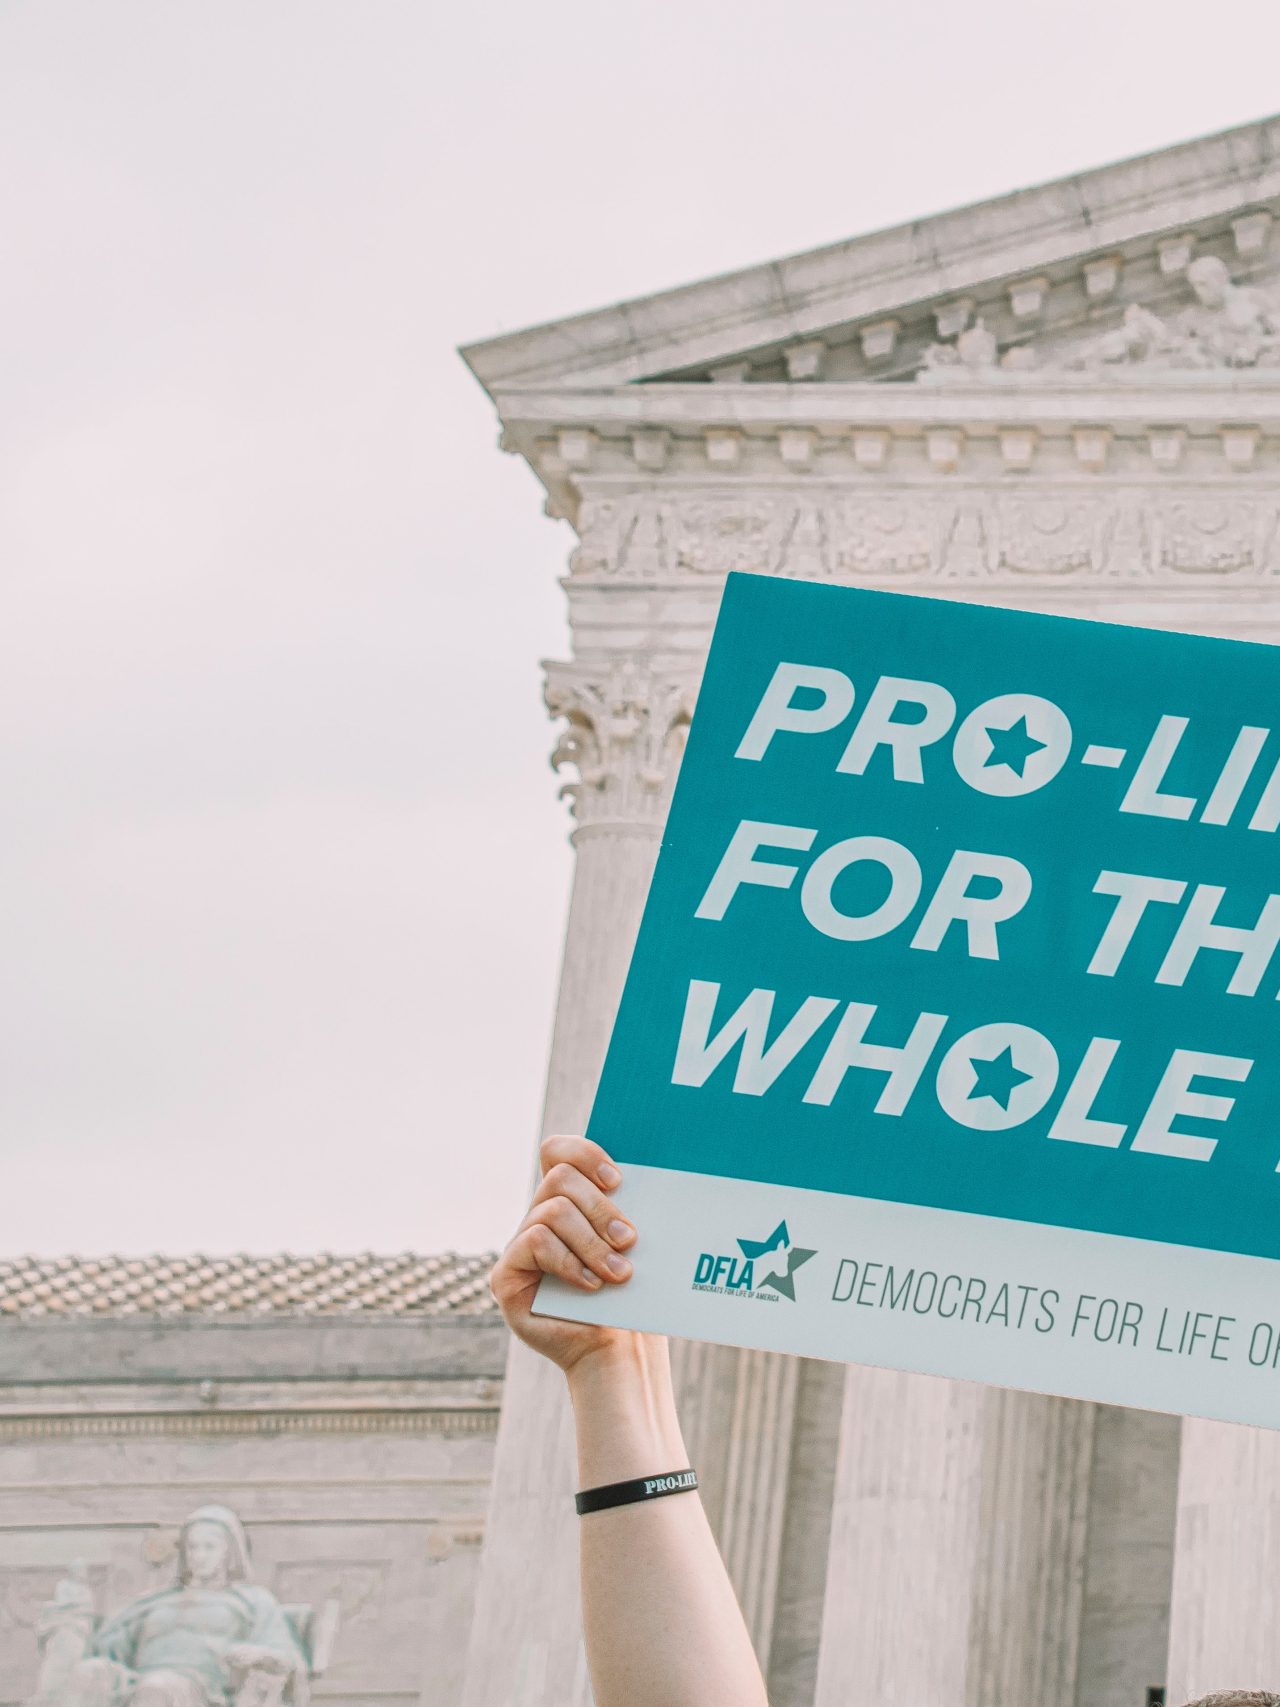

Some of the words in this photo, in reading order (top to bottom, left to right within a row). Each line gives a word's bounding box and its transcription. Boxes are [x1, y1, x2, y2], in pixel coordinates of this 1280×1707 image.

[694, 820, 1033, 961] FOR
[671, 979, 1254, 1162] WHOLE
[691, 1283, 723, 1294] DEMOCRATS
[724, 1287, 735, 1296] FOR
[735, 1289, 747, 1298] LIFE
[747, 1290, 755, 1299] OF
[755, 1292, 779, 1302] AMERICA
[693, 1253, 754, 1291] DFLA
[831, 1258, 1060, 1334] DEMOCRATS
[1070, 1294, 1144, 1348] FOR
[1155, 1307, 1237, 1362] LIFE
